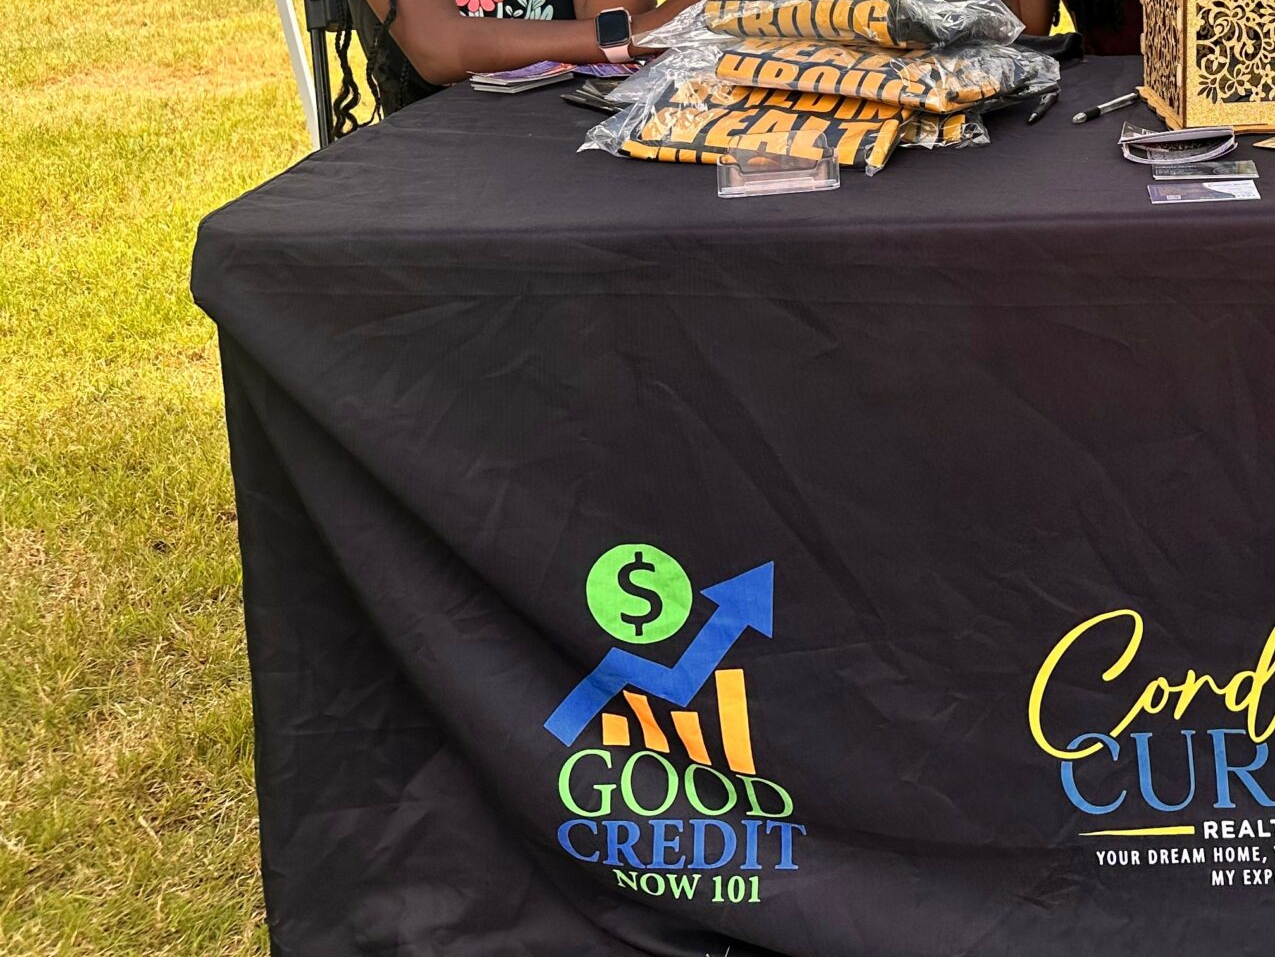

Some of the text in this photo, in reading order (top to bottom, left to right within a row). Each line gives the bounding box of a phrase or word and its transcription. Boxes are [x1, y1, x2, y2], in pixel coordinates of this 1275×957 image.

[558, 748, 794, 817] GOOD
[557, 818, 807, 870] CREDIT
[1096, 848, 1141, 866] YOUR
[1148, 847, 1206, 865] DREAM
[1213, 846, 1268, 865] HOME,
[613, 869, 761, 903] NOW 101
[1211, 868, 1236, 886] MY
